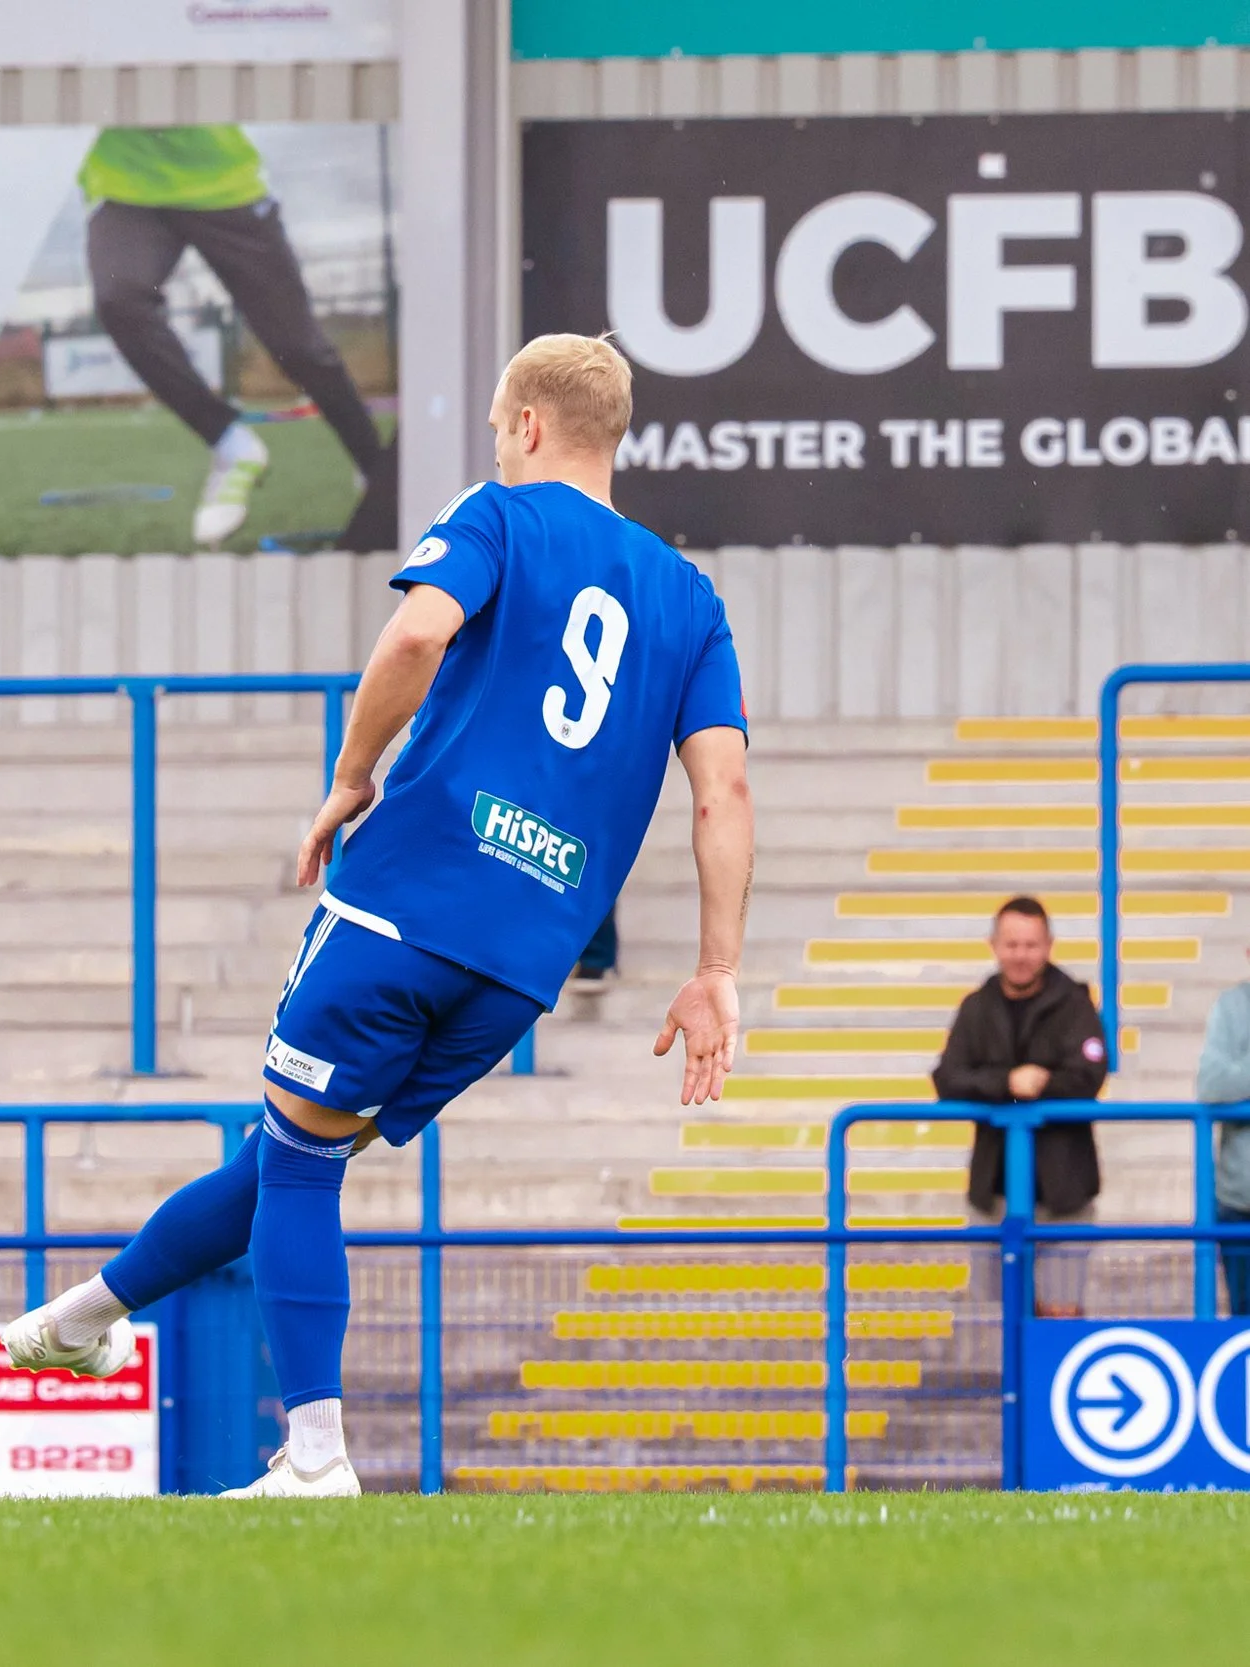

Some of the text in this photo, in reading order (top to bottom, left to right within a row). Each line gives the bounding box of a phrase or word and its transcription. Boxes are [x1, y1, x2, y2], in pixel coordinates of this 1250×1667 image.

[607, 191, 1250, 378] UCFB
[614, 420, 867, 471] MASTER
[878, 418, 1005, 469] THE
[542, 585, 630, 750] 9
[287, 1057, 315, 1073] AZTEK
[36, 1377, 143, 1402] Centre
[10, 1446, 132, 1472] 8229
